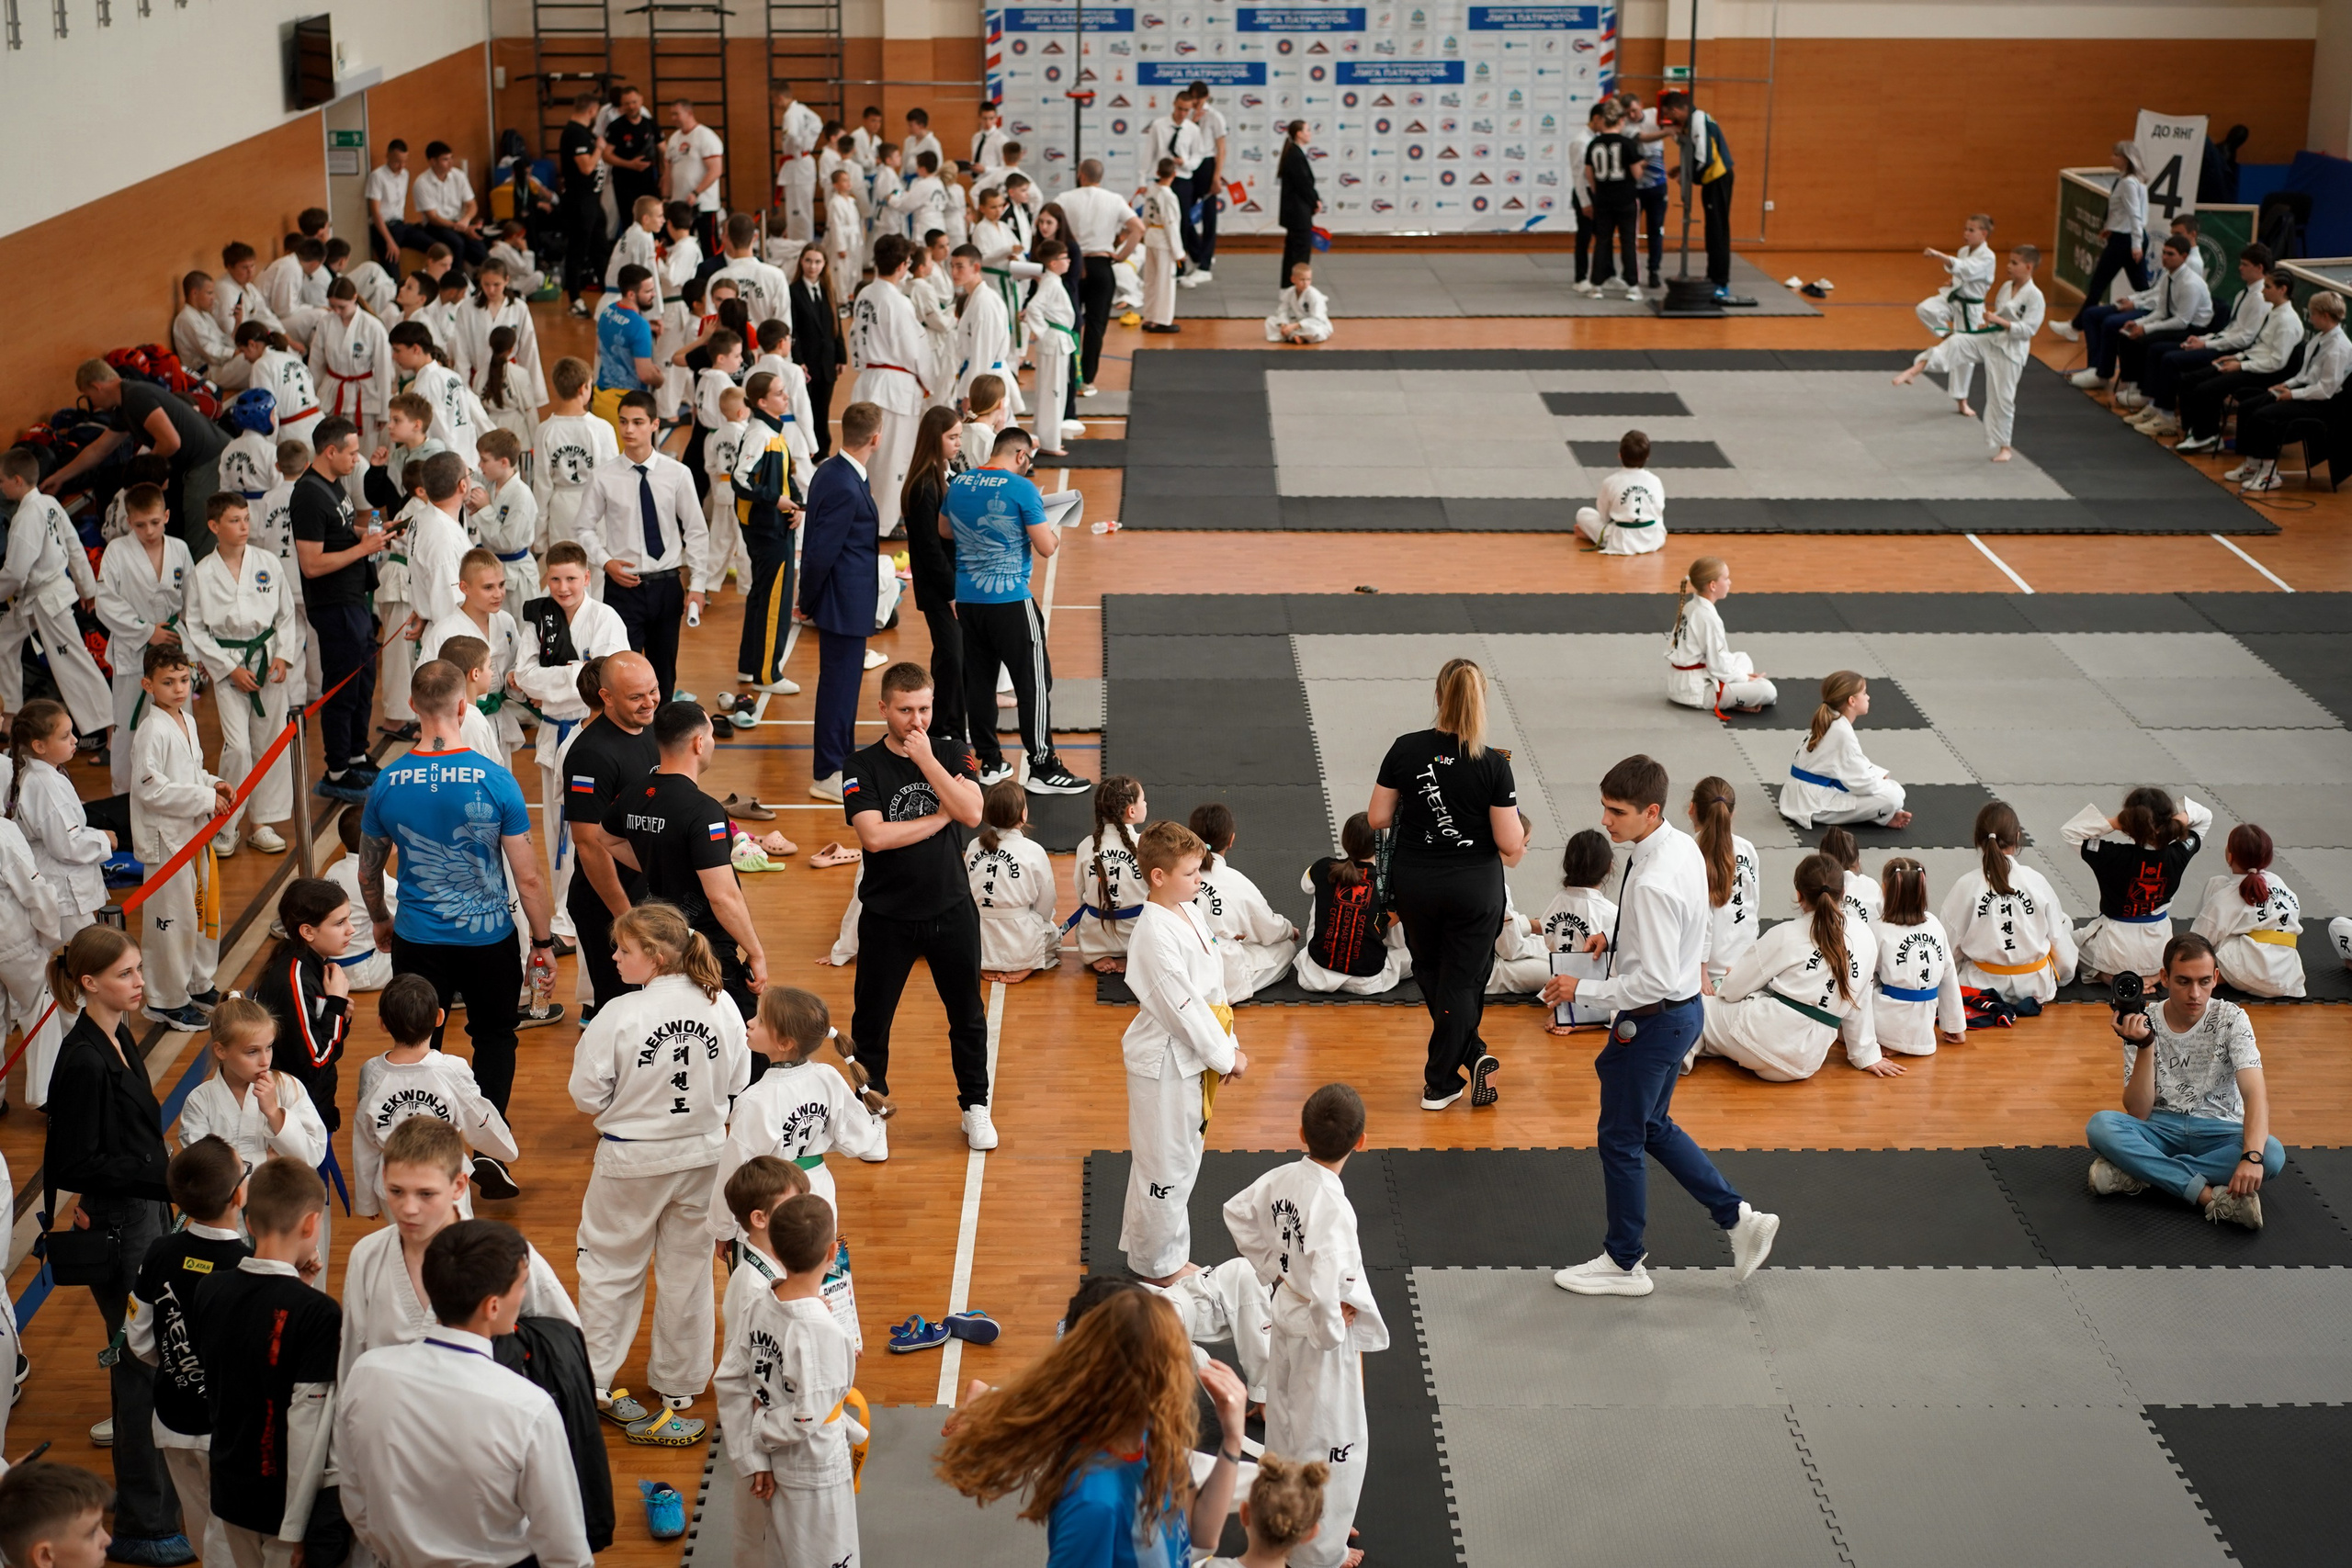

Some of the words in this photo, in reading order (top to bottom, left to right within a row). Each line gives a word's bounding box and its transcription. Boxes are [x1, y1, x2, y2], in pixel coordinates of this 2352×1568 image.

[2151, 124, 2171, 139] ДО
[2172, 126, 2195, 141] ЯНГ
[1591, 142, 1626, 182] 01
[2148, 154, 2183, 220] 4
[1089, 849, 1143, 880] TAKWON-DO
[1977, 888, 2035, 919] TAEKN-DO
[1895, 931, 1943, 966] TAEKWON-DO
[638, 1019, 719, 1068] TAEKWON-DO
[823, 1280, 847, 1296] ДИПЛОМ
[658, 1436, 694, 1447] crocs
